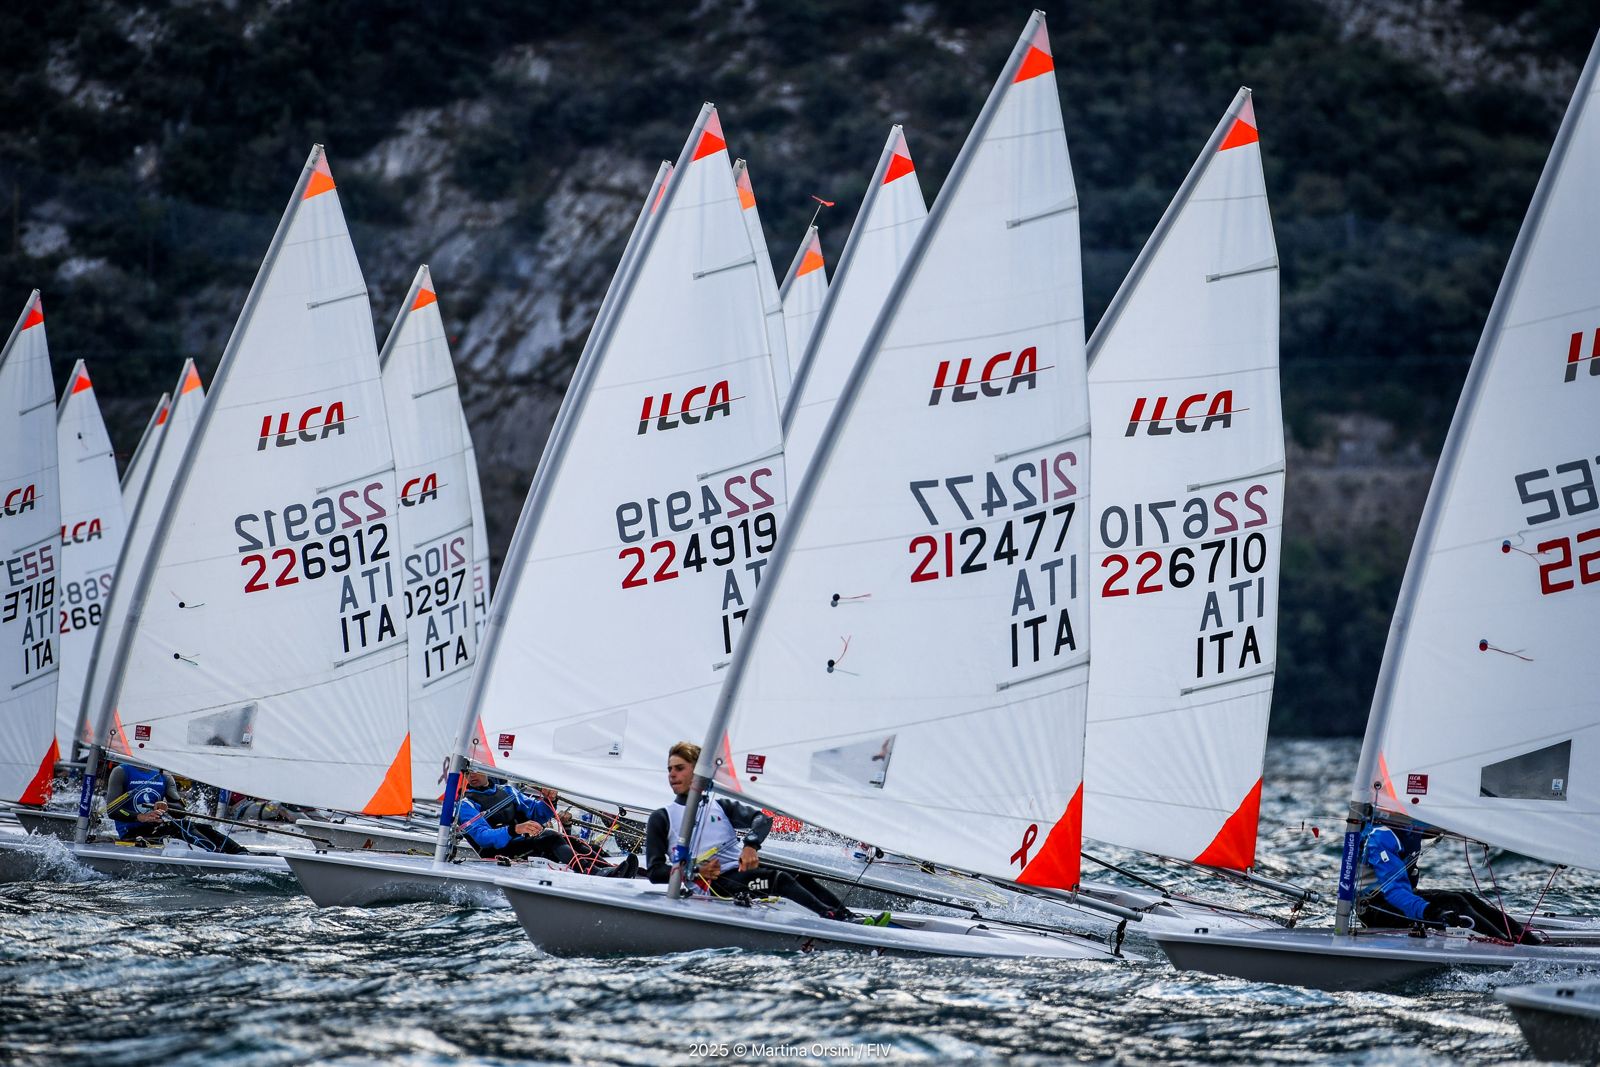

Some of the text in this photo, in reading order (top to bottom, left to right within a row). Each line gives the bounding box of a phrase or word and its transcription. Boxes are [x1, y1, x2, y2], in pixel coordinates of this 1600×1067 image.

[928, 346, 1037, 407] ILCA
[257, 401, 345, 452] ILCA
[637, 380, 731, 436] ILCA
[1125, 389, 1233, 437] ILCA
[0, 484, 35, 518] CA
[398, 473, 438, 509] CA
[240, 523, 391, 594] 226912
[618, 512, 777, 590] 224919
[908, 502, 1076, 583] 212477
[1100, 532, 1267, 598] 226710
[340, 603, 397, 654] ITA
[1011, 607, 1077, 668] ITA
[1196, 625, 1262, 679] ITA
[24, 638, 54, 675] ITA
[424, 634, 469, 679] ITA
[1343, 833, 1355, 880] Negrinautica
[748, 877, 769, 891] Gill
